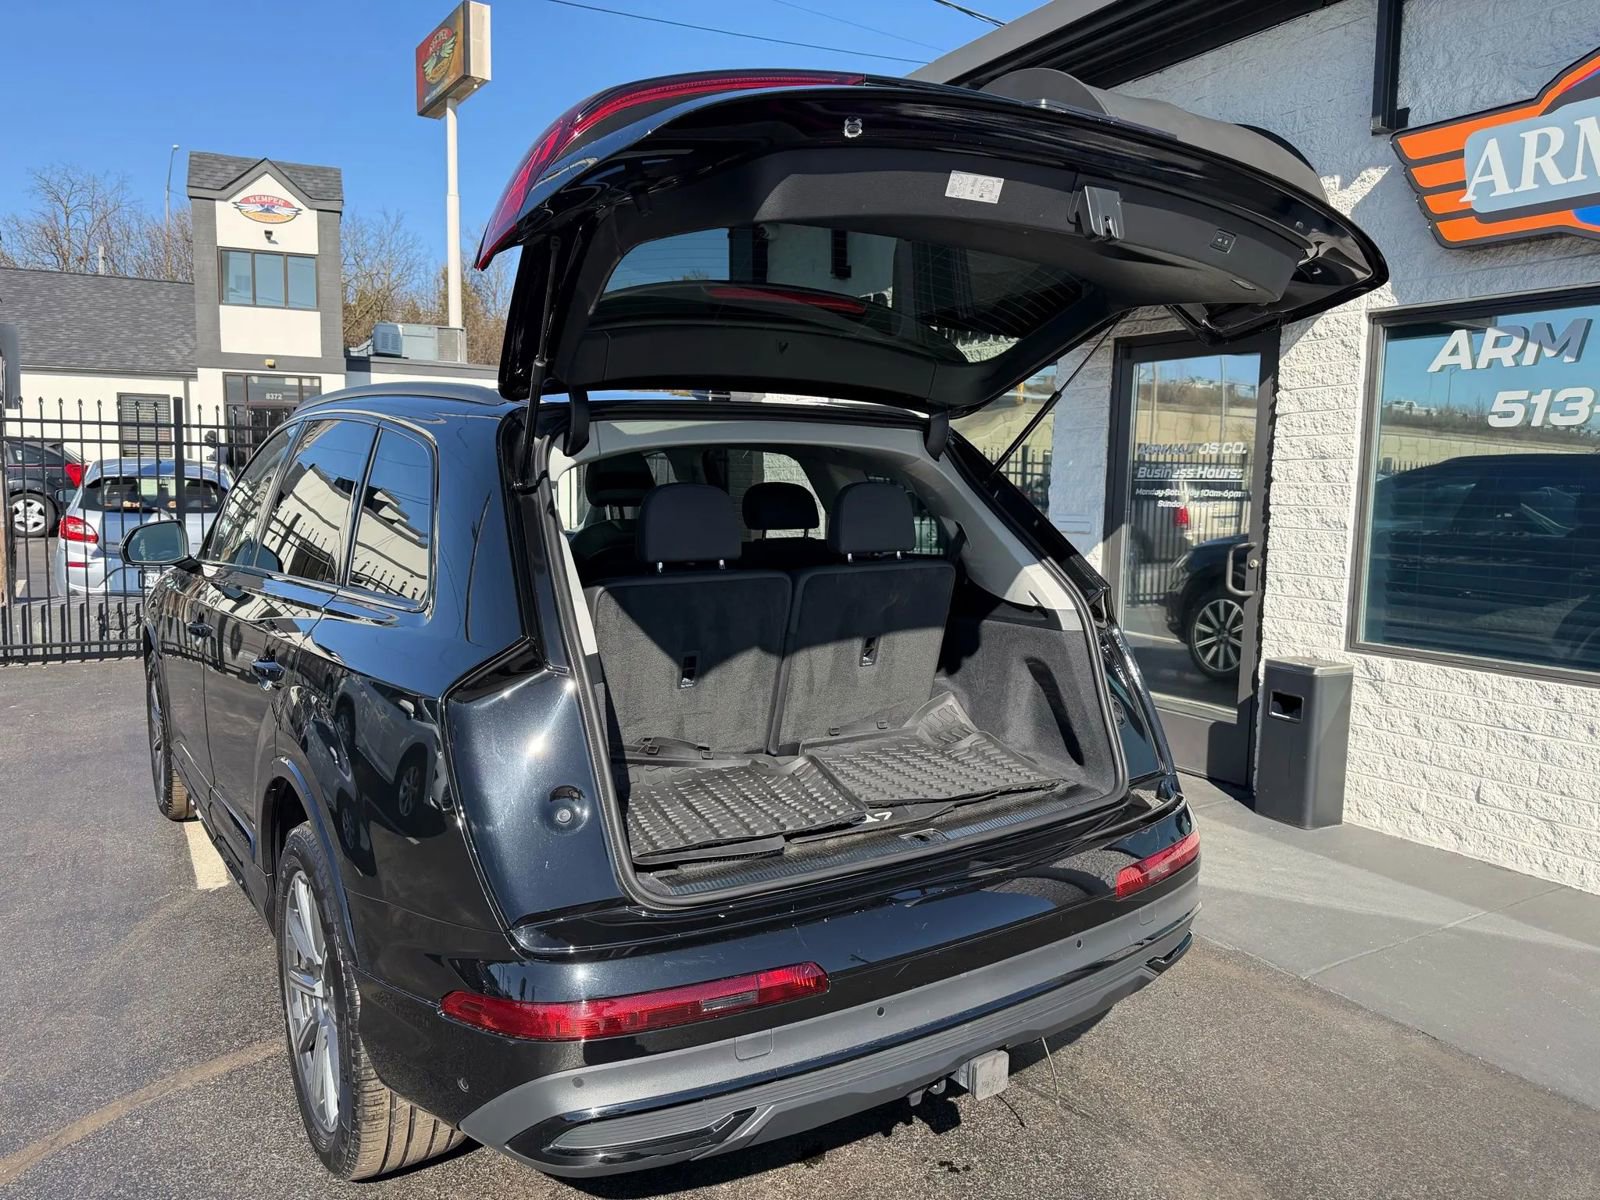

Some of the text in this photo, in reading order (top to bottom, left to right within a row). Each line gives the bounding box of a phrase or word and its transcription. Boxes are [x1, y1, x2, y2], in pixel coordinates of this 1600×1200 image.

[1427, 318, 1593, 373] ARM
[1218, 441, 1248, 455] CO.
[1137, 466, 1243, 479] Business Hours:
